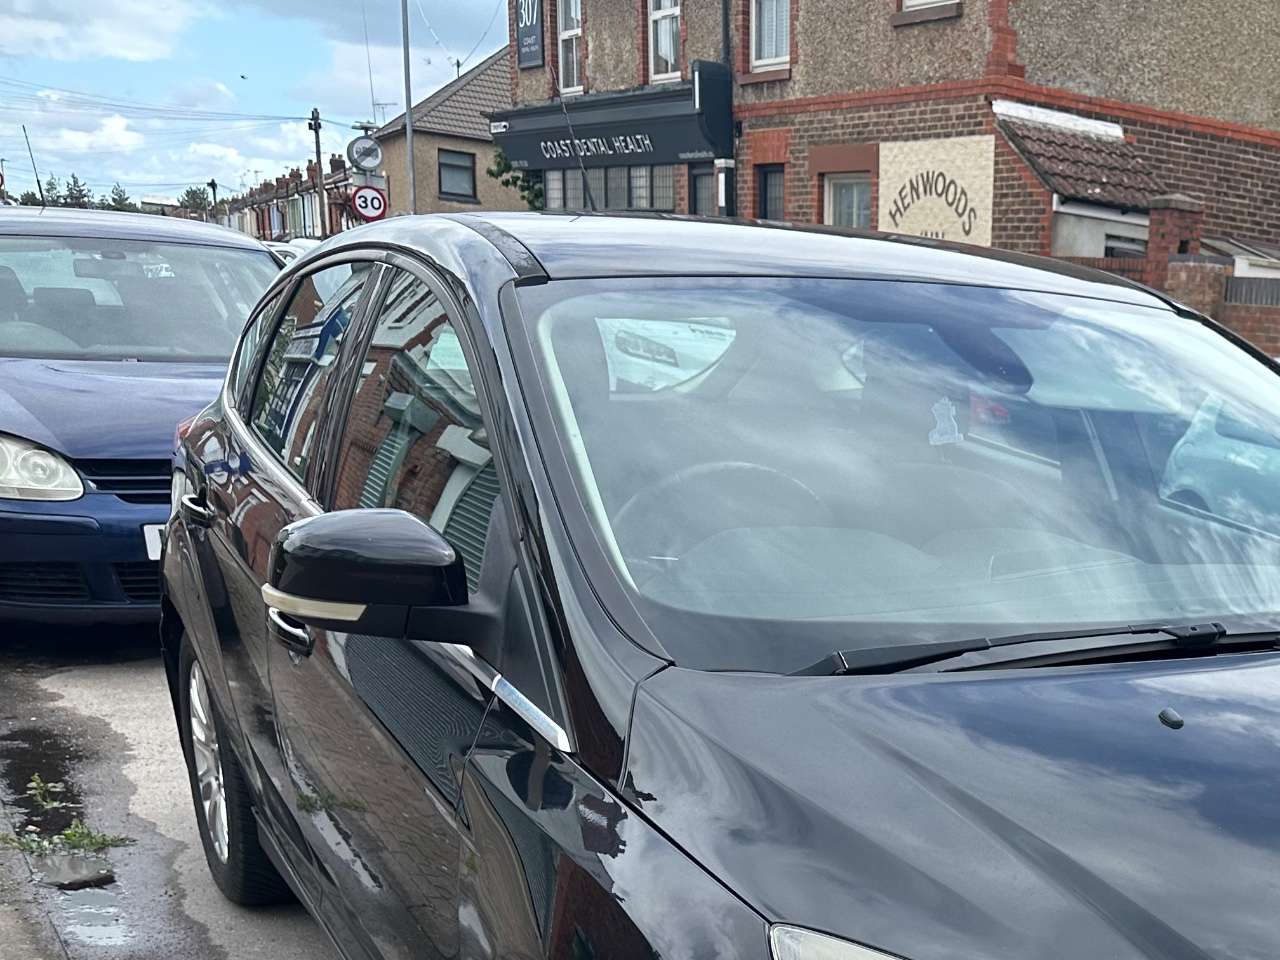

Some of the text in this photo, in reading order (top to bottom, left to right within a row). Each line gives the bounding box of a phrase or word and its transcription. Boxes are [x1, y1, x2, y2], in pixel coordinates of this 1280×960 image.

[540, 134, 653, 158] COAST DENTAL HEALTH
[358, 195, 382, 210] 30
[888, 169, 977, 236] HENWOODS
